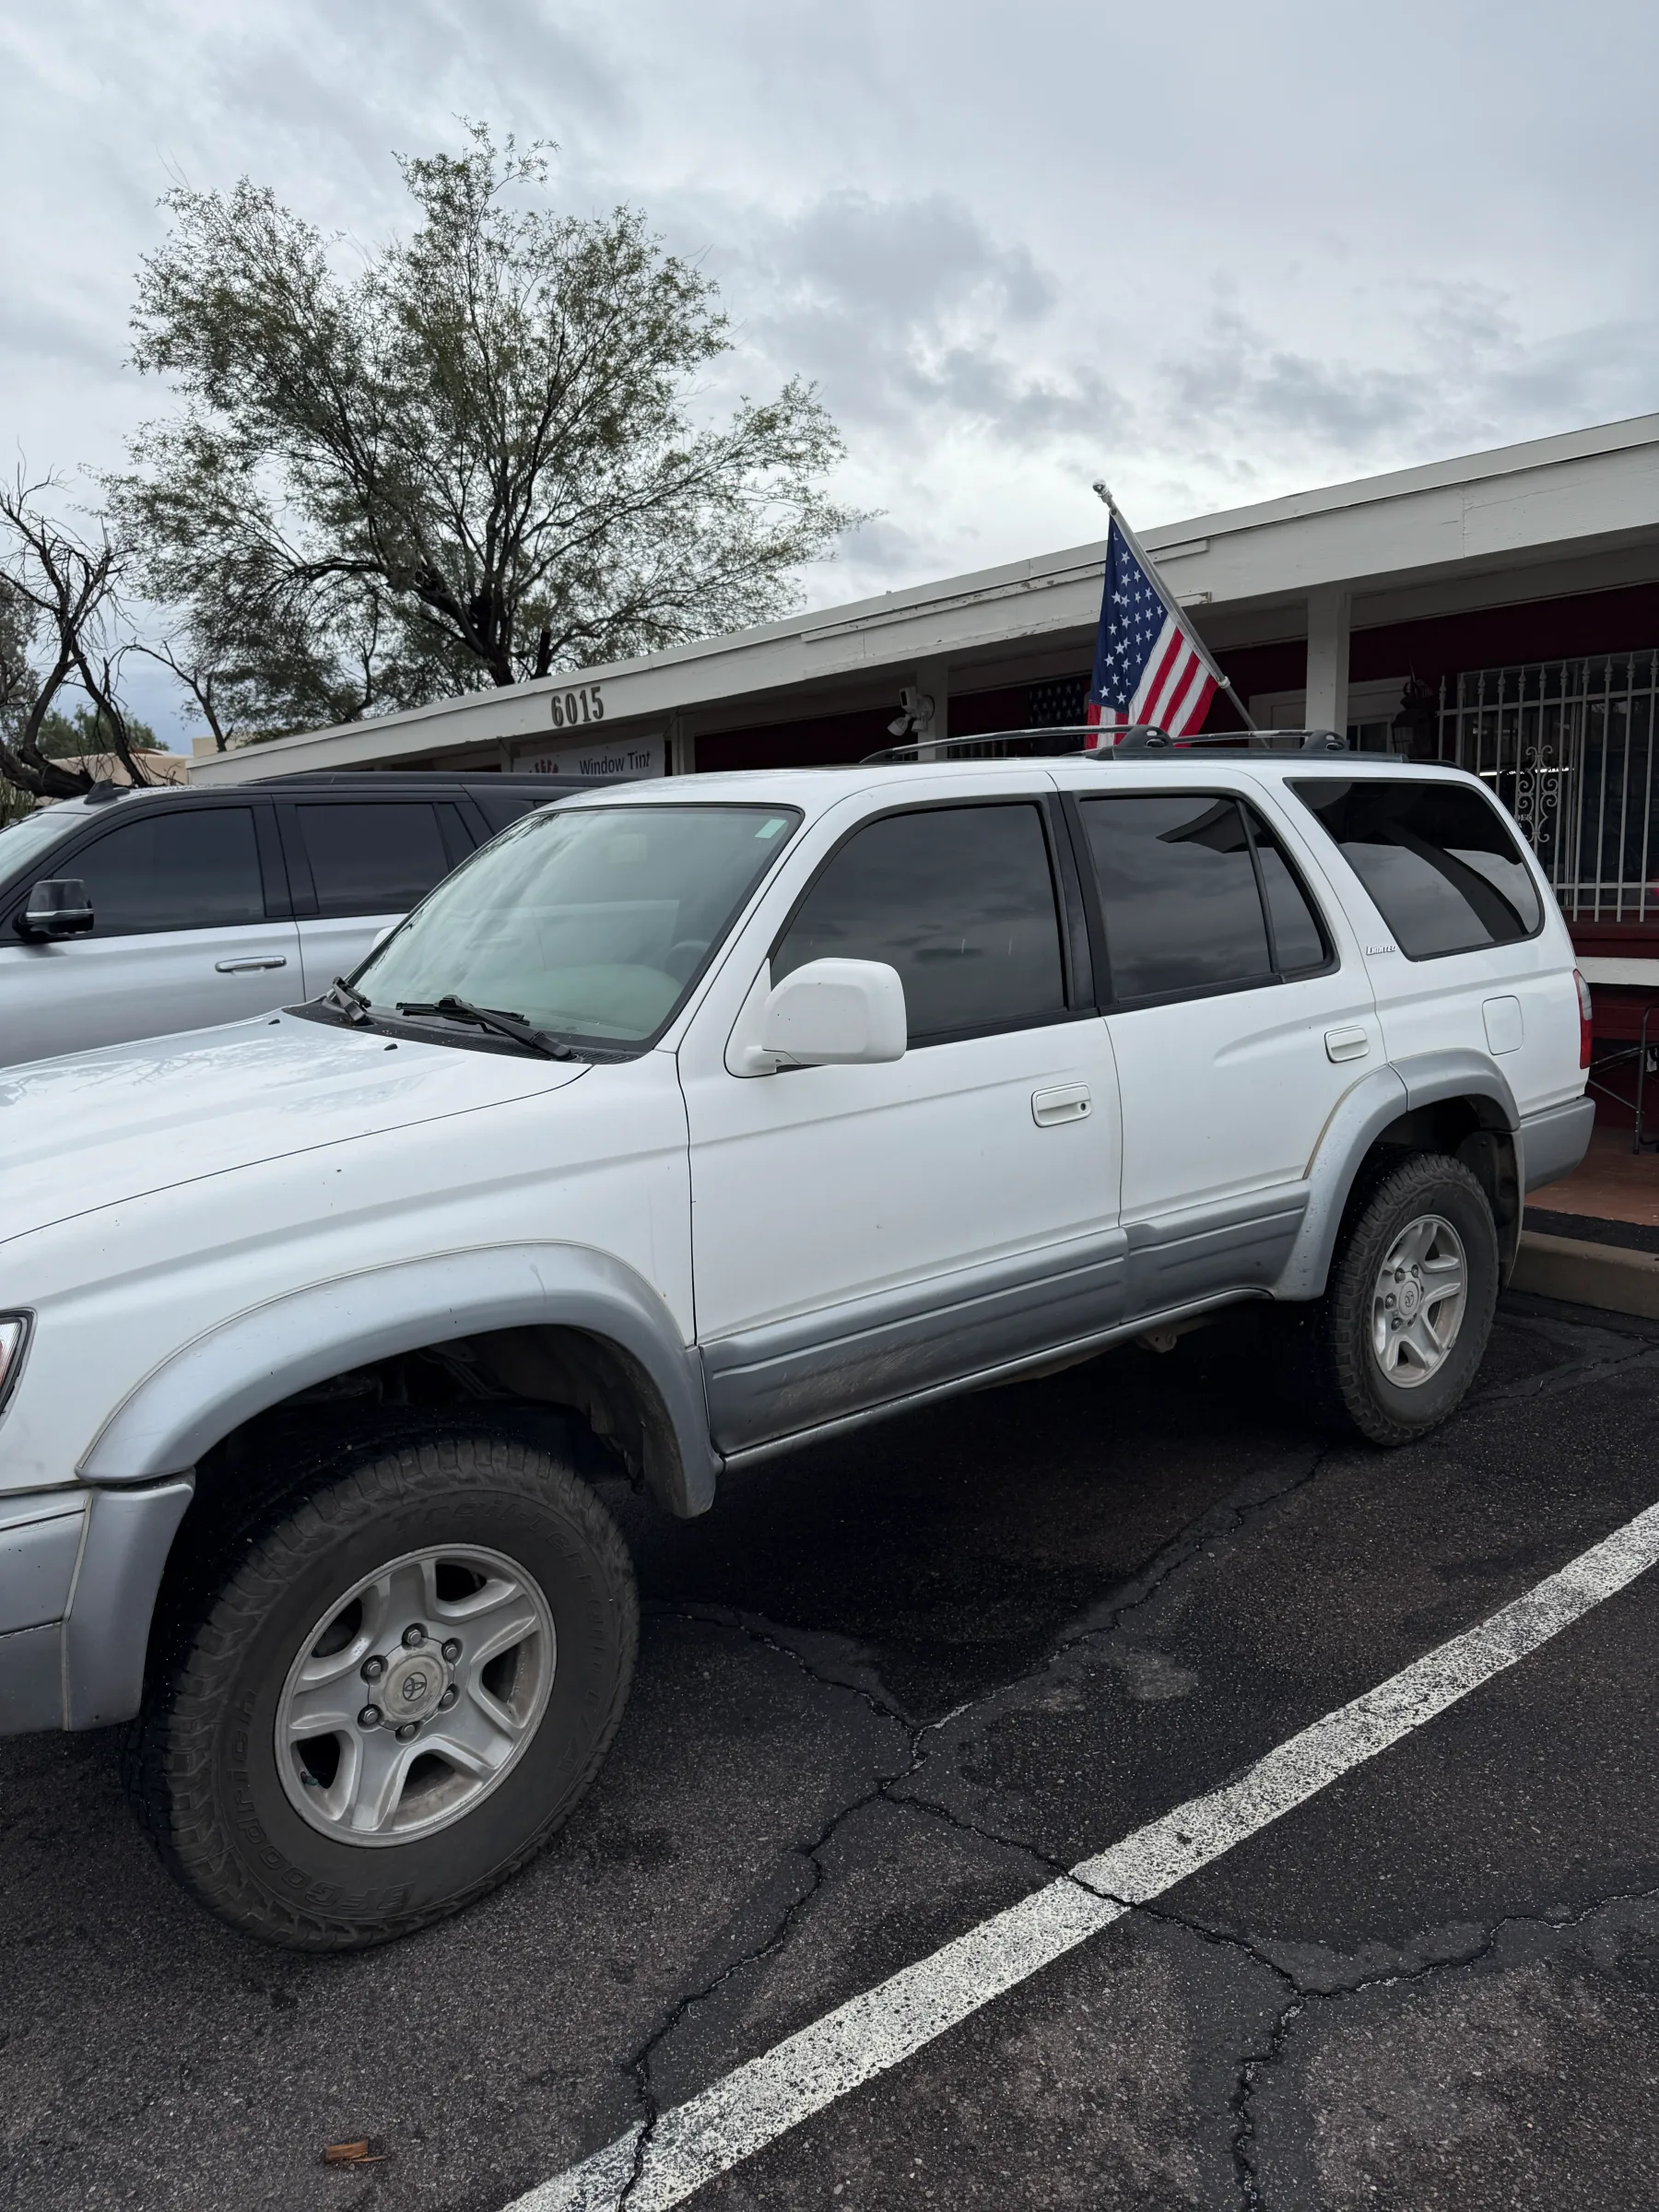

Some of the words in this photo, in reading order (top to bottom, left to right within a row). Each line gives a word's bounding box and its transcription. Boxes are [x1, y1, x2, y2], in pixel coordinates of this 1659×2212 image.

[551, 686, 605, 726] 6015
[579, 757, 625, 775] Window
[627, 750, 651, 771] Tint
[228, 1688, 415, 1912] BFGoodrich
